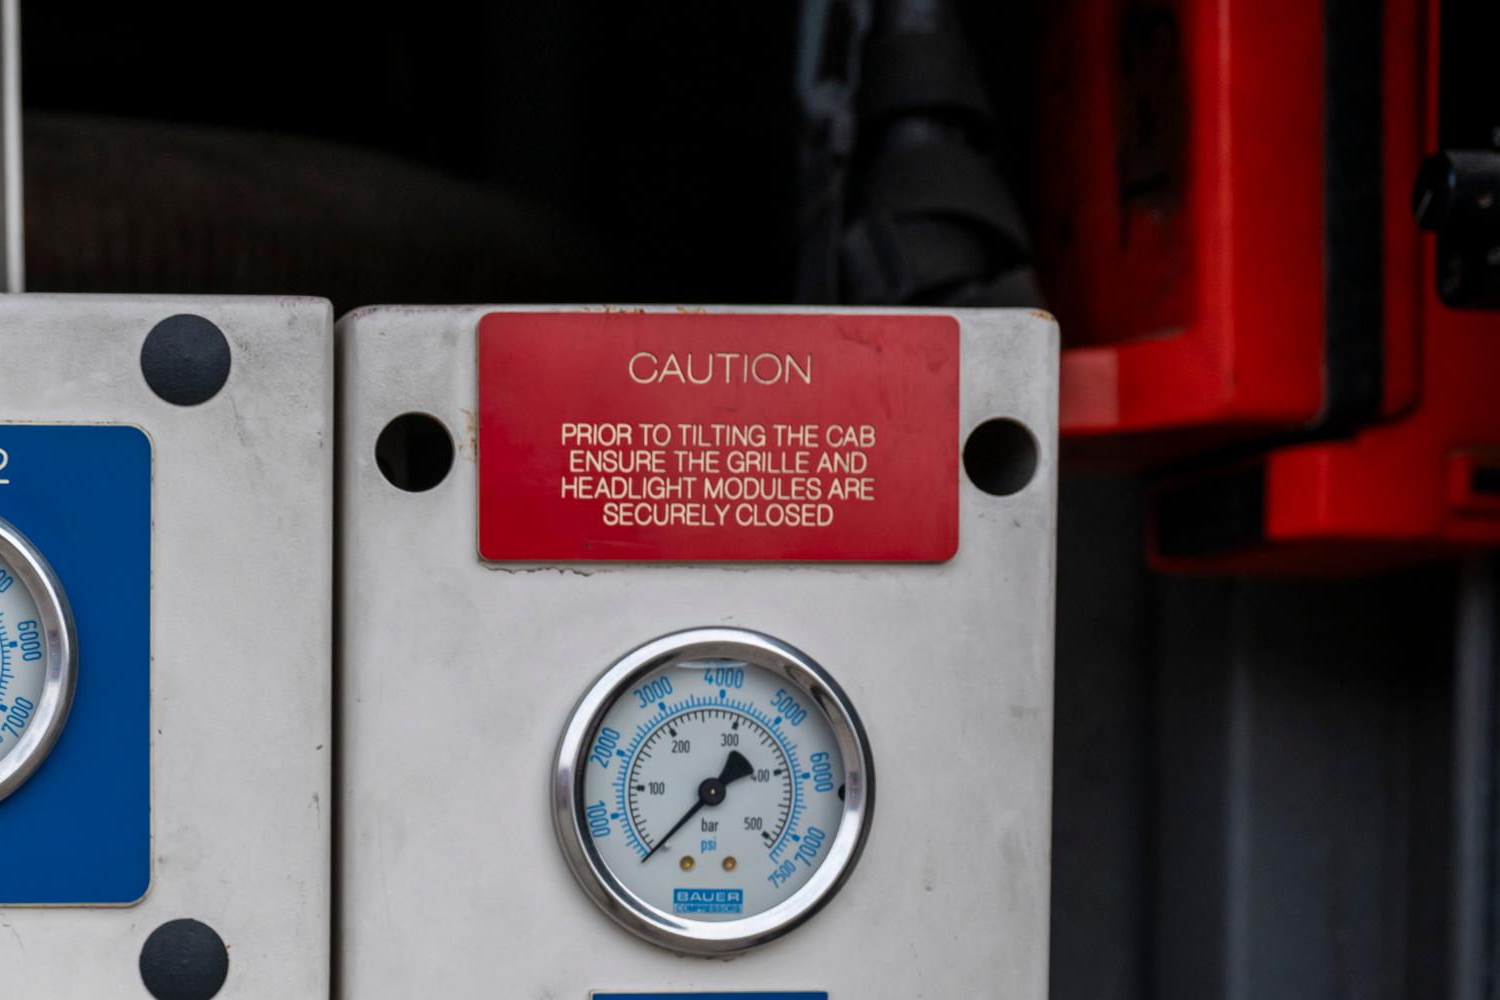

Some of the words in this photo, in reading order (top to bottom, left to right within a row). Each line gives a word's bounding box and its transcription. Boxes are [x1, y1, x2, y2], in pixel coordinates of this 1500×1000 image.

[628, 352, 812, 385] CAUTION
[561, 423, 632, 447] PRIOR
[639, 424, 672, 447] TO
[678, 425, 766, 447] TILTING
[774, 425, 818, 447] THE
[825, 425, 876, 447] CAB
[570, 451, 665, 473] ENSURE
[674, 452, 720, 473] THE
[726, 452, 810, 473] GRILLE
[816, 452, 867, 474] AND
[561, 477, 697, 499] HEADLIGHT
[704, 478, 822, 500] MODULES
[828, 478, 874, 500] ARE
[603, 504, 730, 526] SECURELY
[735, 504, 833, 527] CLOSED
[17, 620, 41, 661] 6000
[704, 667, 744, 688] 4000
[633, 676, 673, 709] 3000
[1, 696, 34, 737] 7000
[770, 689, 807, 727] 5000
[590, 727, 620, 768] 2000
[672, 740, 690, 753] 200
[721, 734, 739, 746] 300
[810, 752, 833, 792] 6000
[648, 782, 664, 795] 100
[587, 800, 611, 838] 1000
[701, 818, 718, 831] bar
[744, 817, 762, 830] 500
[701, 837, 716, 853] psi
[795, 827, 826, 867] 7000
[768, 860, 797, 888] 7500
[677, 891, 740, 901] BAUER
